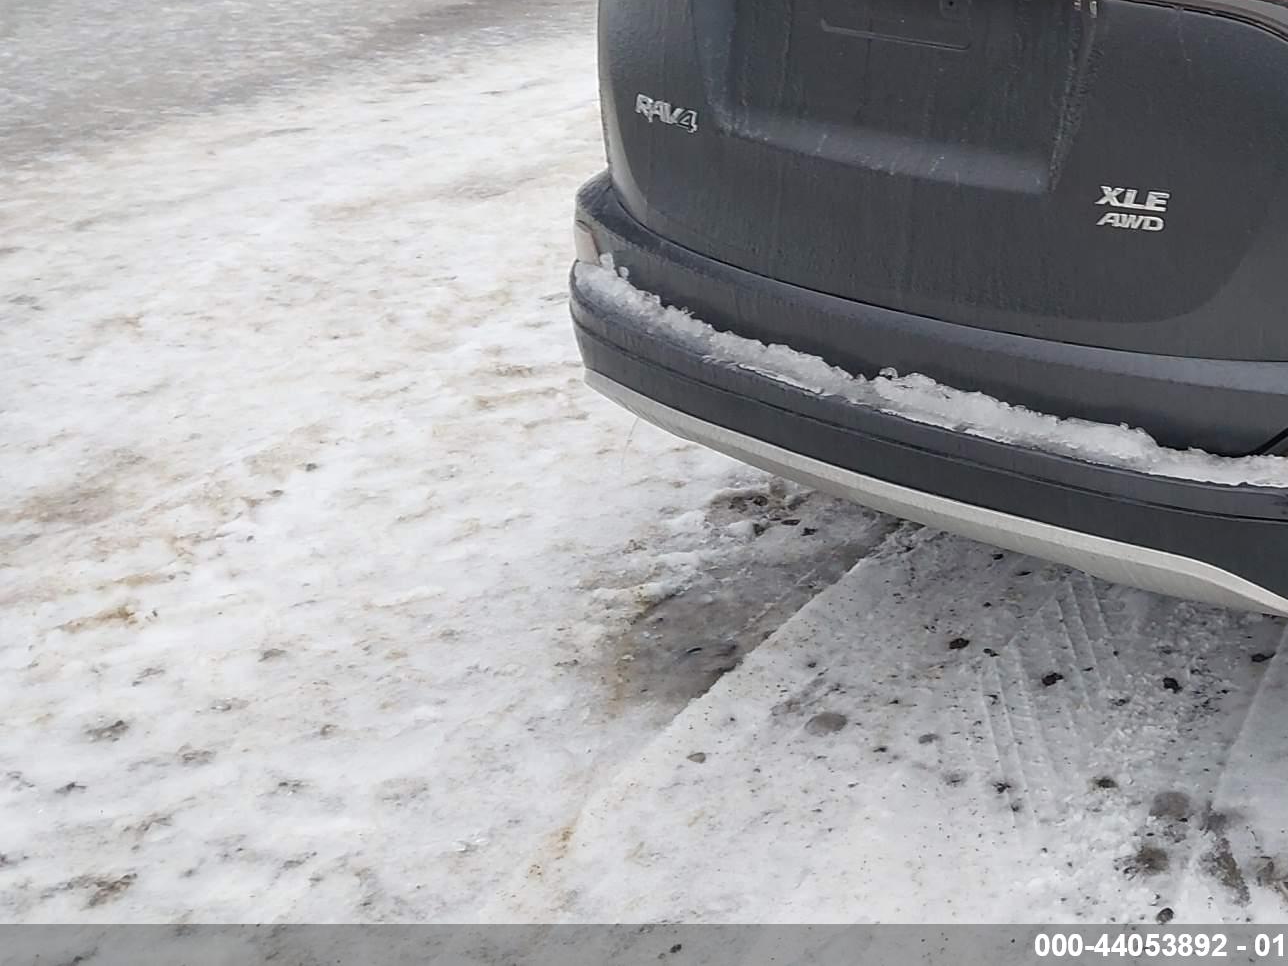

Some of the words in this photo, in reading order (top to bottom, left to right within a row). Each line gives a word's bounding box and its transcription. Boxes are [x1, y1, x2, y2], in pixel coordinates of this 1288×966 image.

[635, 93, 698, 133] RAV4
[1094, 185, 1170, 212] XLE
[1096, 212, 1164, 231] AWD
